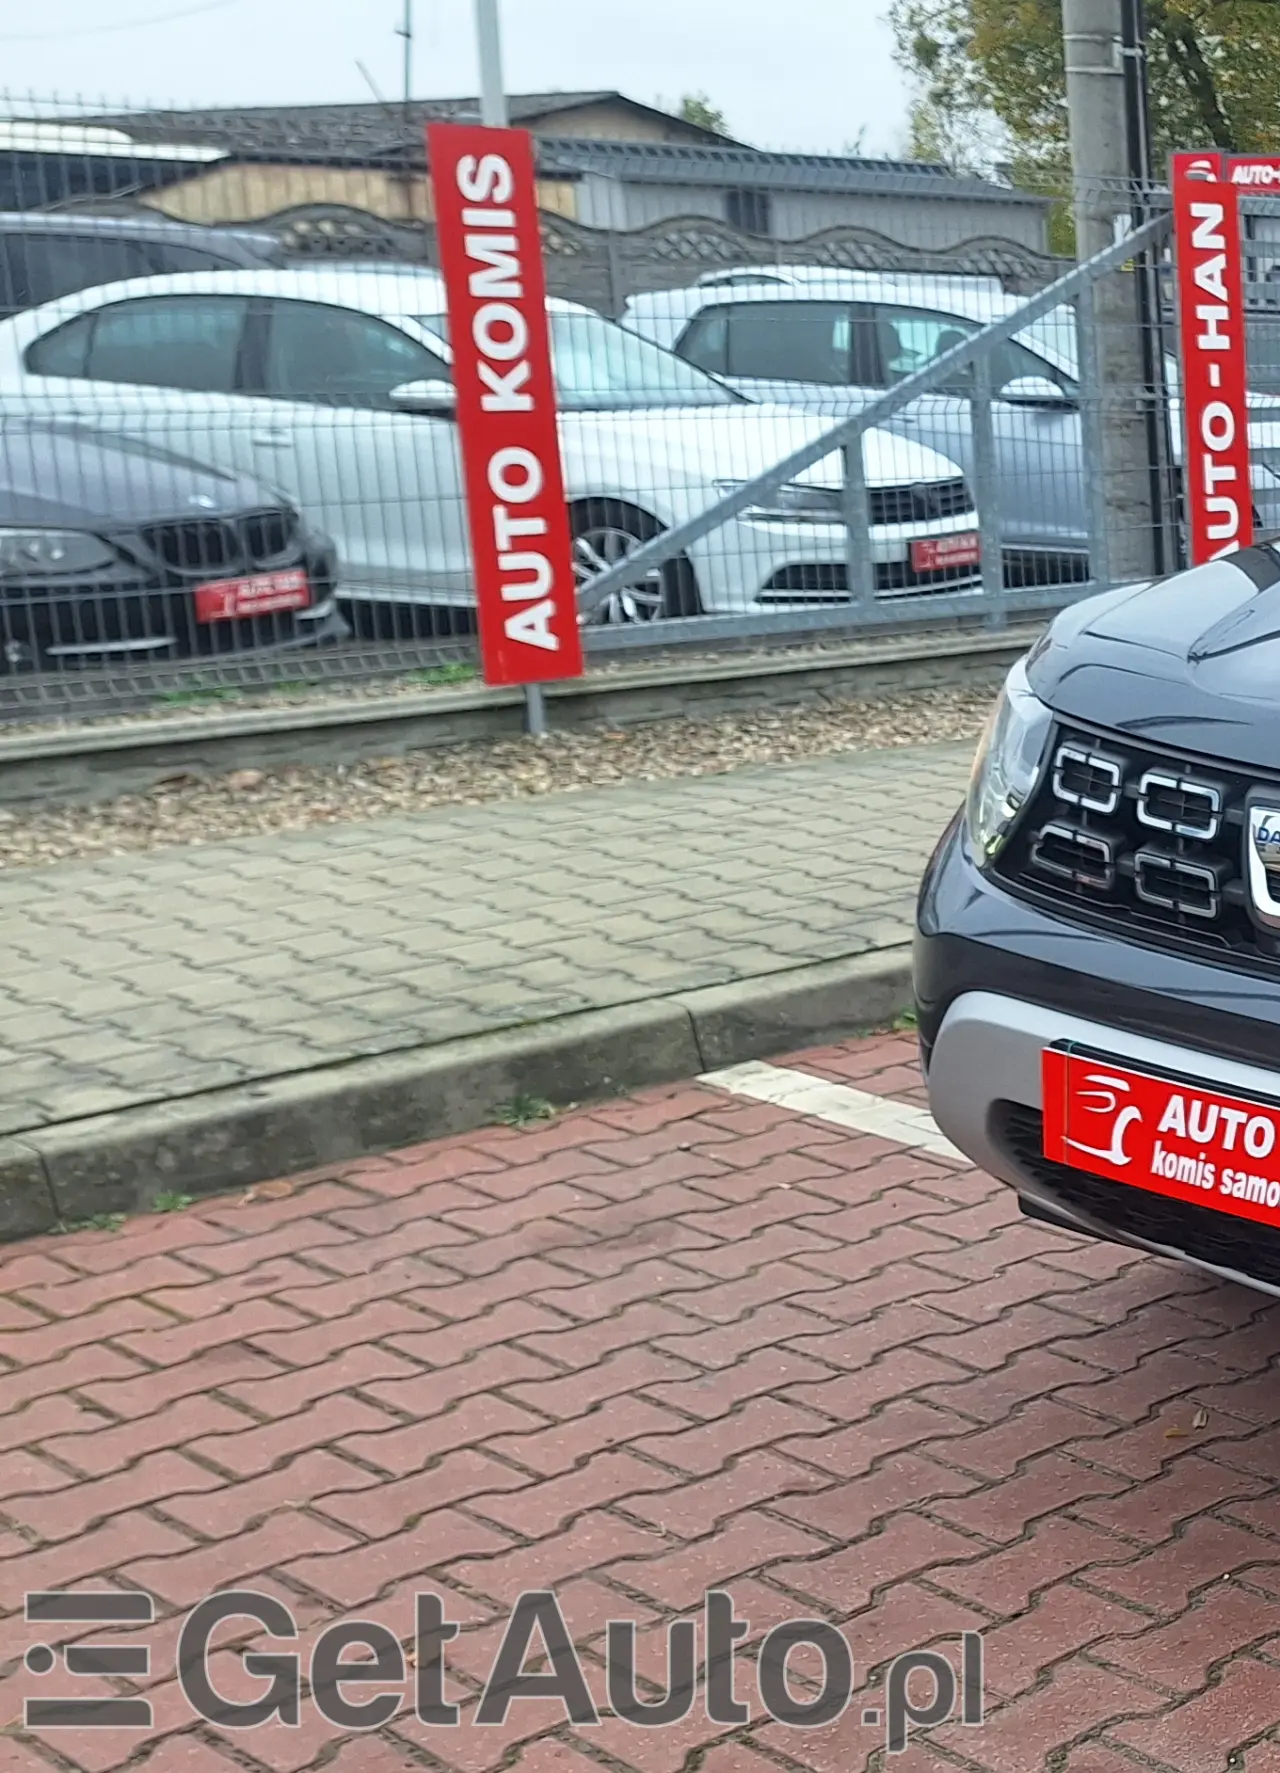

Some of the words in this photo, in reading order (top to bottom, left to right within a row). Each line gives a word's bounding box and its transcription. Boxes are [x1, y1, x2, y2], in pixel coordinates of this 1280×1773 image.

[456, 153, 535, 412] KOMIS
[487, 445, 560, 652] AUTO
[1151, 1140, 1216, 1190] komis
[1157, 1094, 1275, 1158] AUTO
